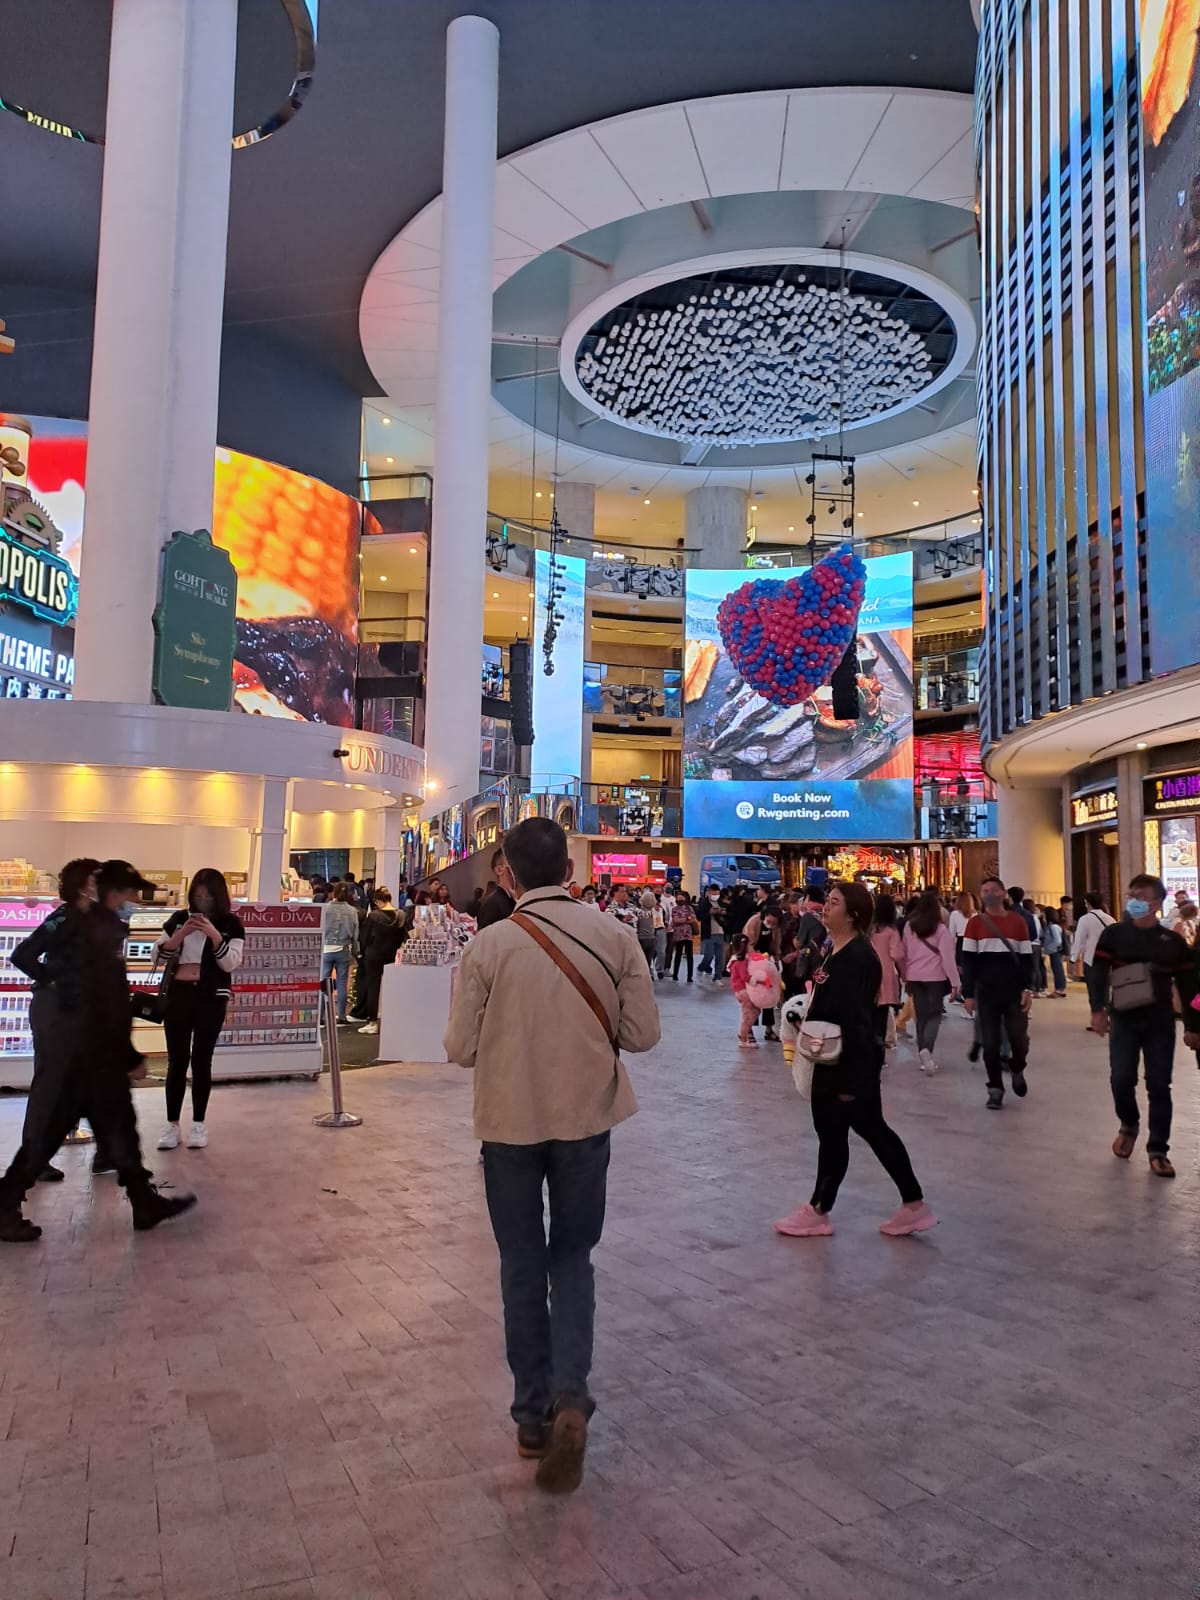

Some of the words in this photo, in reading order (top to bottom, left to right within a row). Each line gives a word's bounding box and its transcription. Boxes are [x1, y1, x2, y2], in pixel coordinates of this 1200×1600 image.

[205, 592, 228, 607] WALK
[190, 631, 208, 648] Sky
[0, 632, 51, 678] THEME
[773, 792, 802, 803] Book
[805, 792, 831, 803] Now
[758, 807, 850, 821] Rwgenting.com
[234, 911, 273, 922] HING
[281, 911, 314, 922] DIVA
